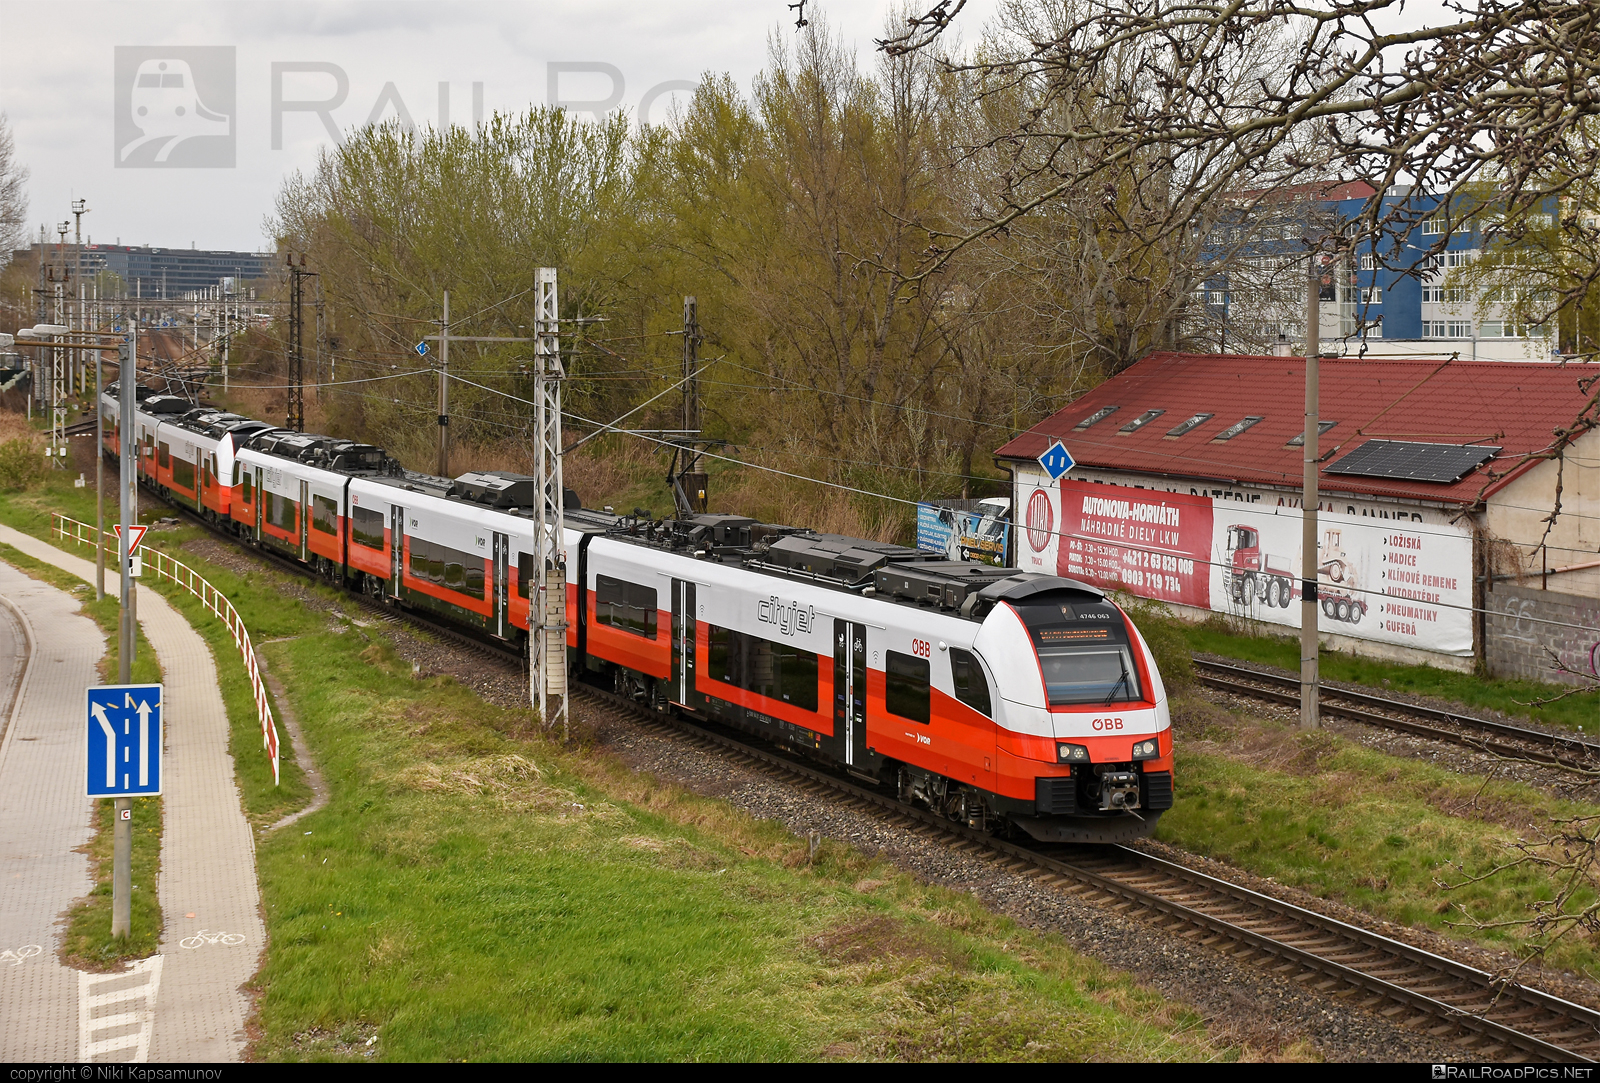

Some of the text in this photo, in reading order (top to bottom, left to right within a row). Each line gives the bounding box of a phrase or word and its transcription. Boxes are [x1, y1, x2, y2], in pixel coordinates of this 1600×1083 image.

[1082, 496, 1180, 527] AUTONOVA-HORVÁTH
[1080, 516, 1180, 546] NÁHRADNÉ DIELY LKW
[980, 540, 1004, 553] SERVIS
[1389, 534, 1421, 550] LOŽISKÁ
[1031, 556, 1043, 566] TRUCK
[1122, 550, 1194, 575] +421 2 63 829 008
[1388, 552, 1416, 567] HADICE
[1122, 568, 1181, 593] 0903 719 734
[1387, 568, 1457, 590] KLÍNOVÉ REMENE
[757, 595, 815, 636] cityjet
[1386, 603, 1438, 622] PNEUMATIKY
[1386, 620, 1417, 636] GUFERÁ
[912, 638, 930, 658] ÖBB
[1092, 718, 1124, 731] ÖBB
